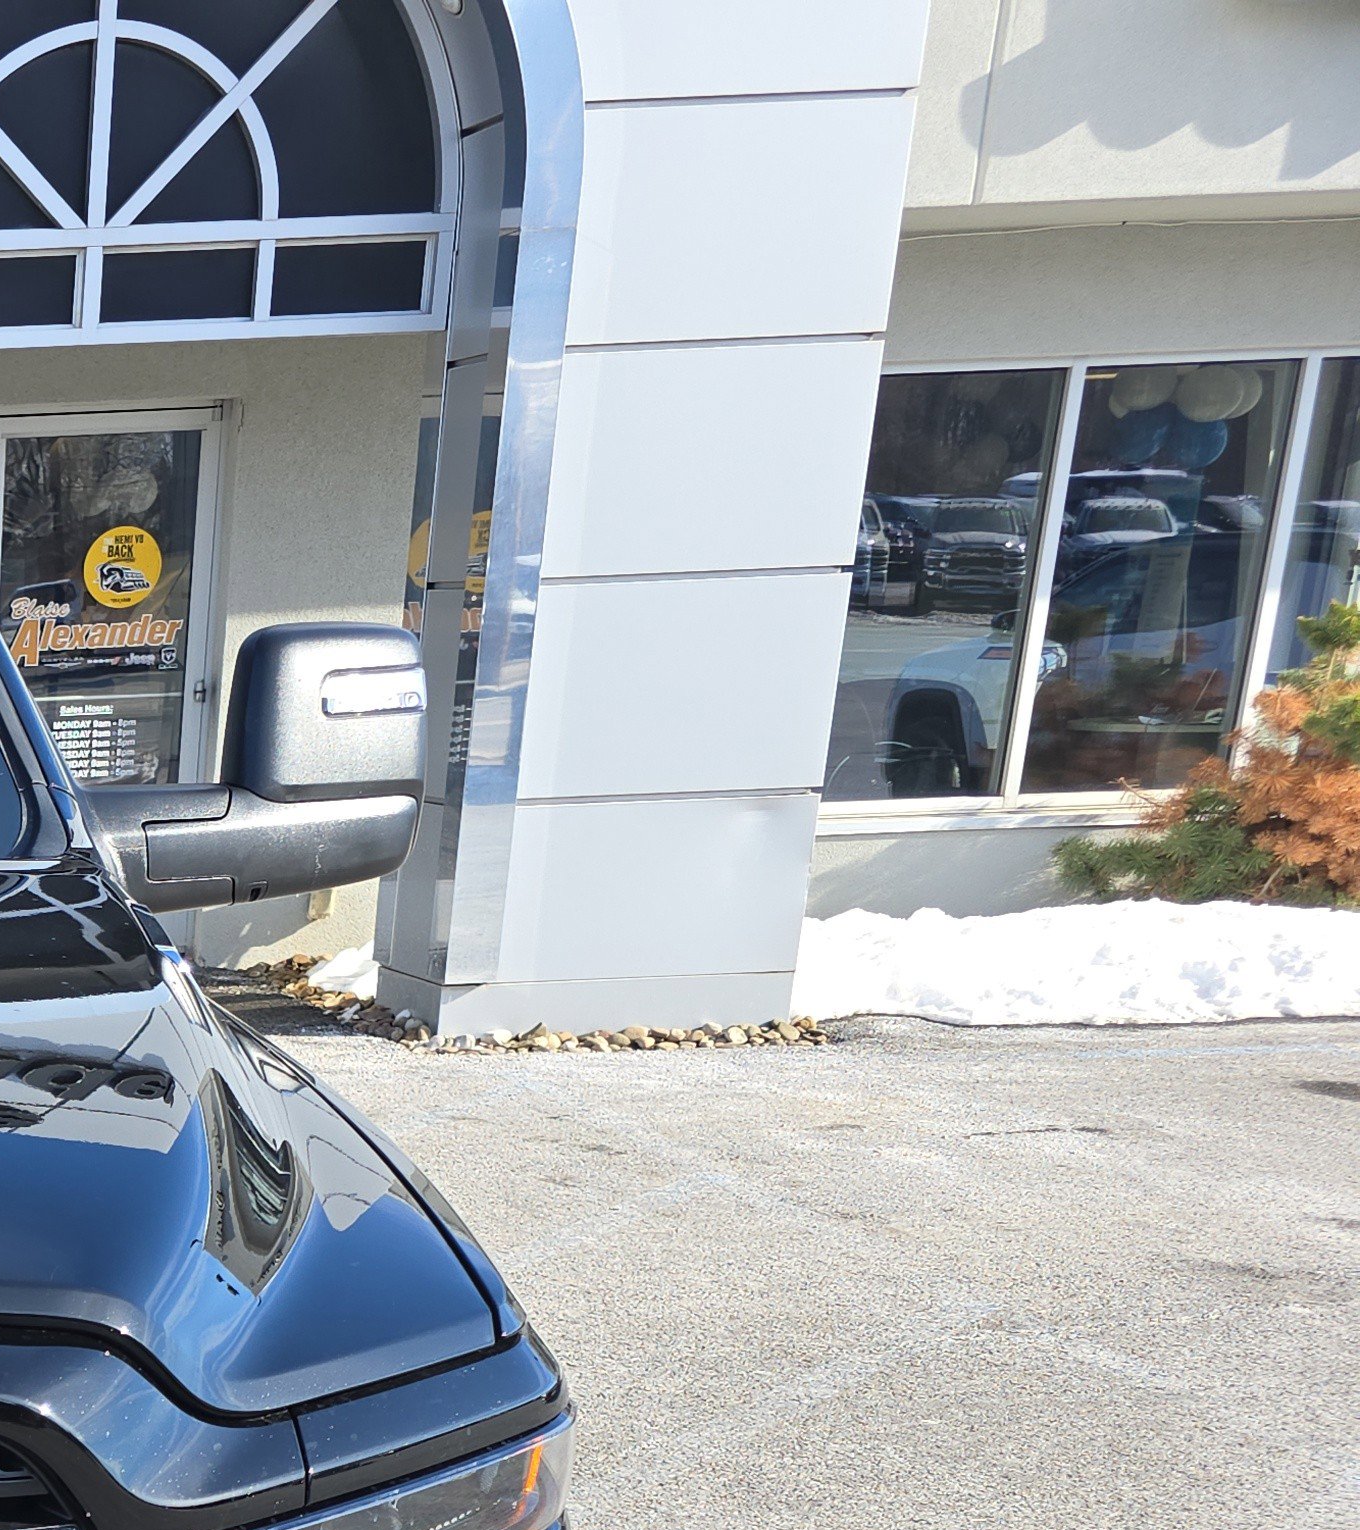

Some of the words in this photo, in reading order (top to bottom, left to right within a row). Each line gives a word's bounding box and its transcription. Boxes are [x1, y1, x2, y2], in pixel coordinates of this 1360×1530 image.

[107, 545, 134, 558] BACK
[10, 597, 71, 620] Blaise
[10, 613, 183, 667] Alexander
[53, 720, 92, 730] MONDAY
